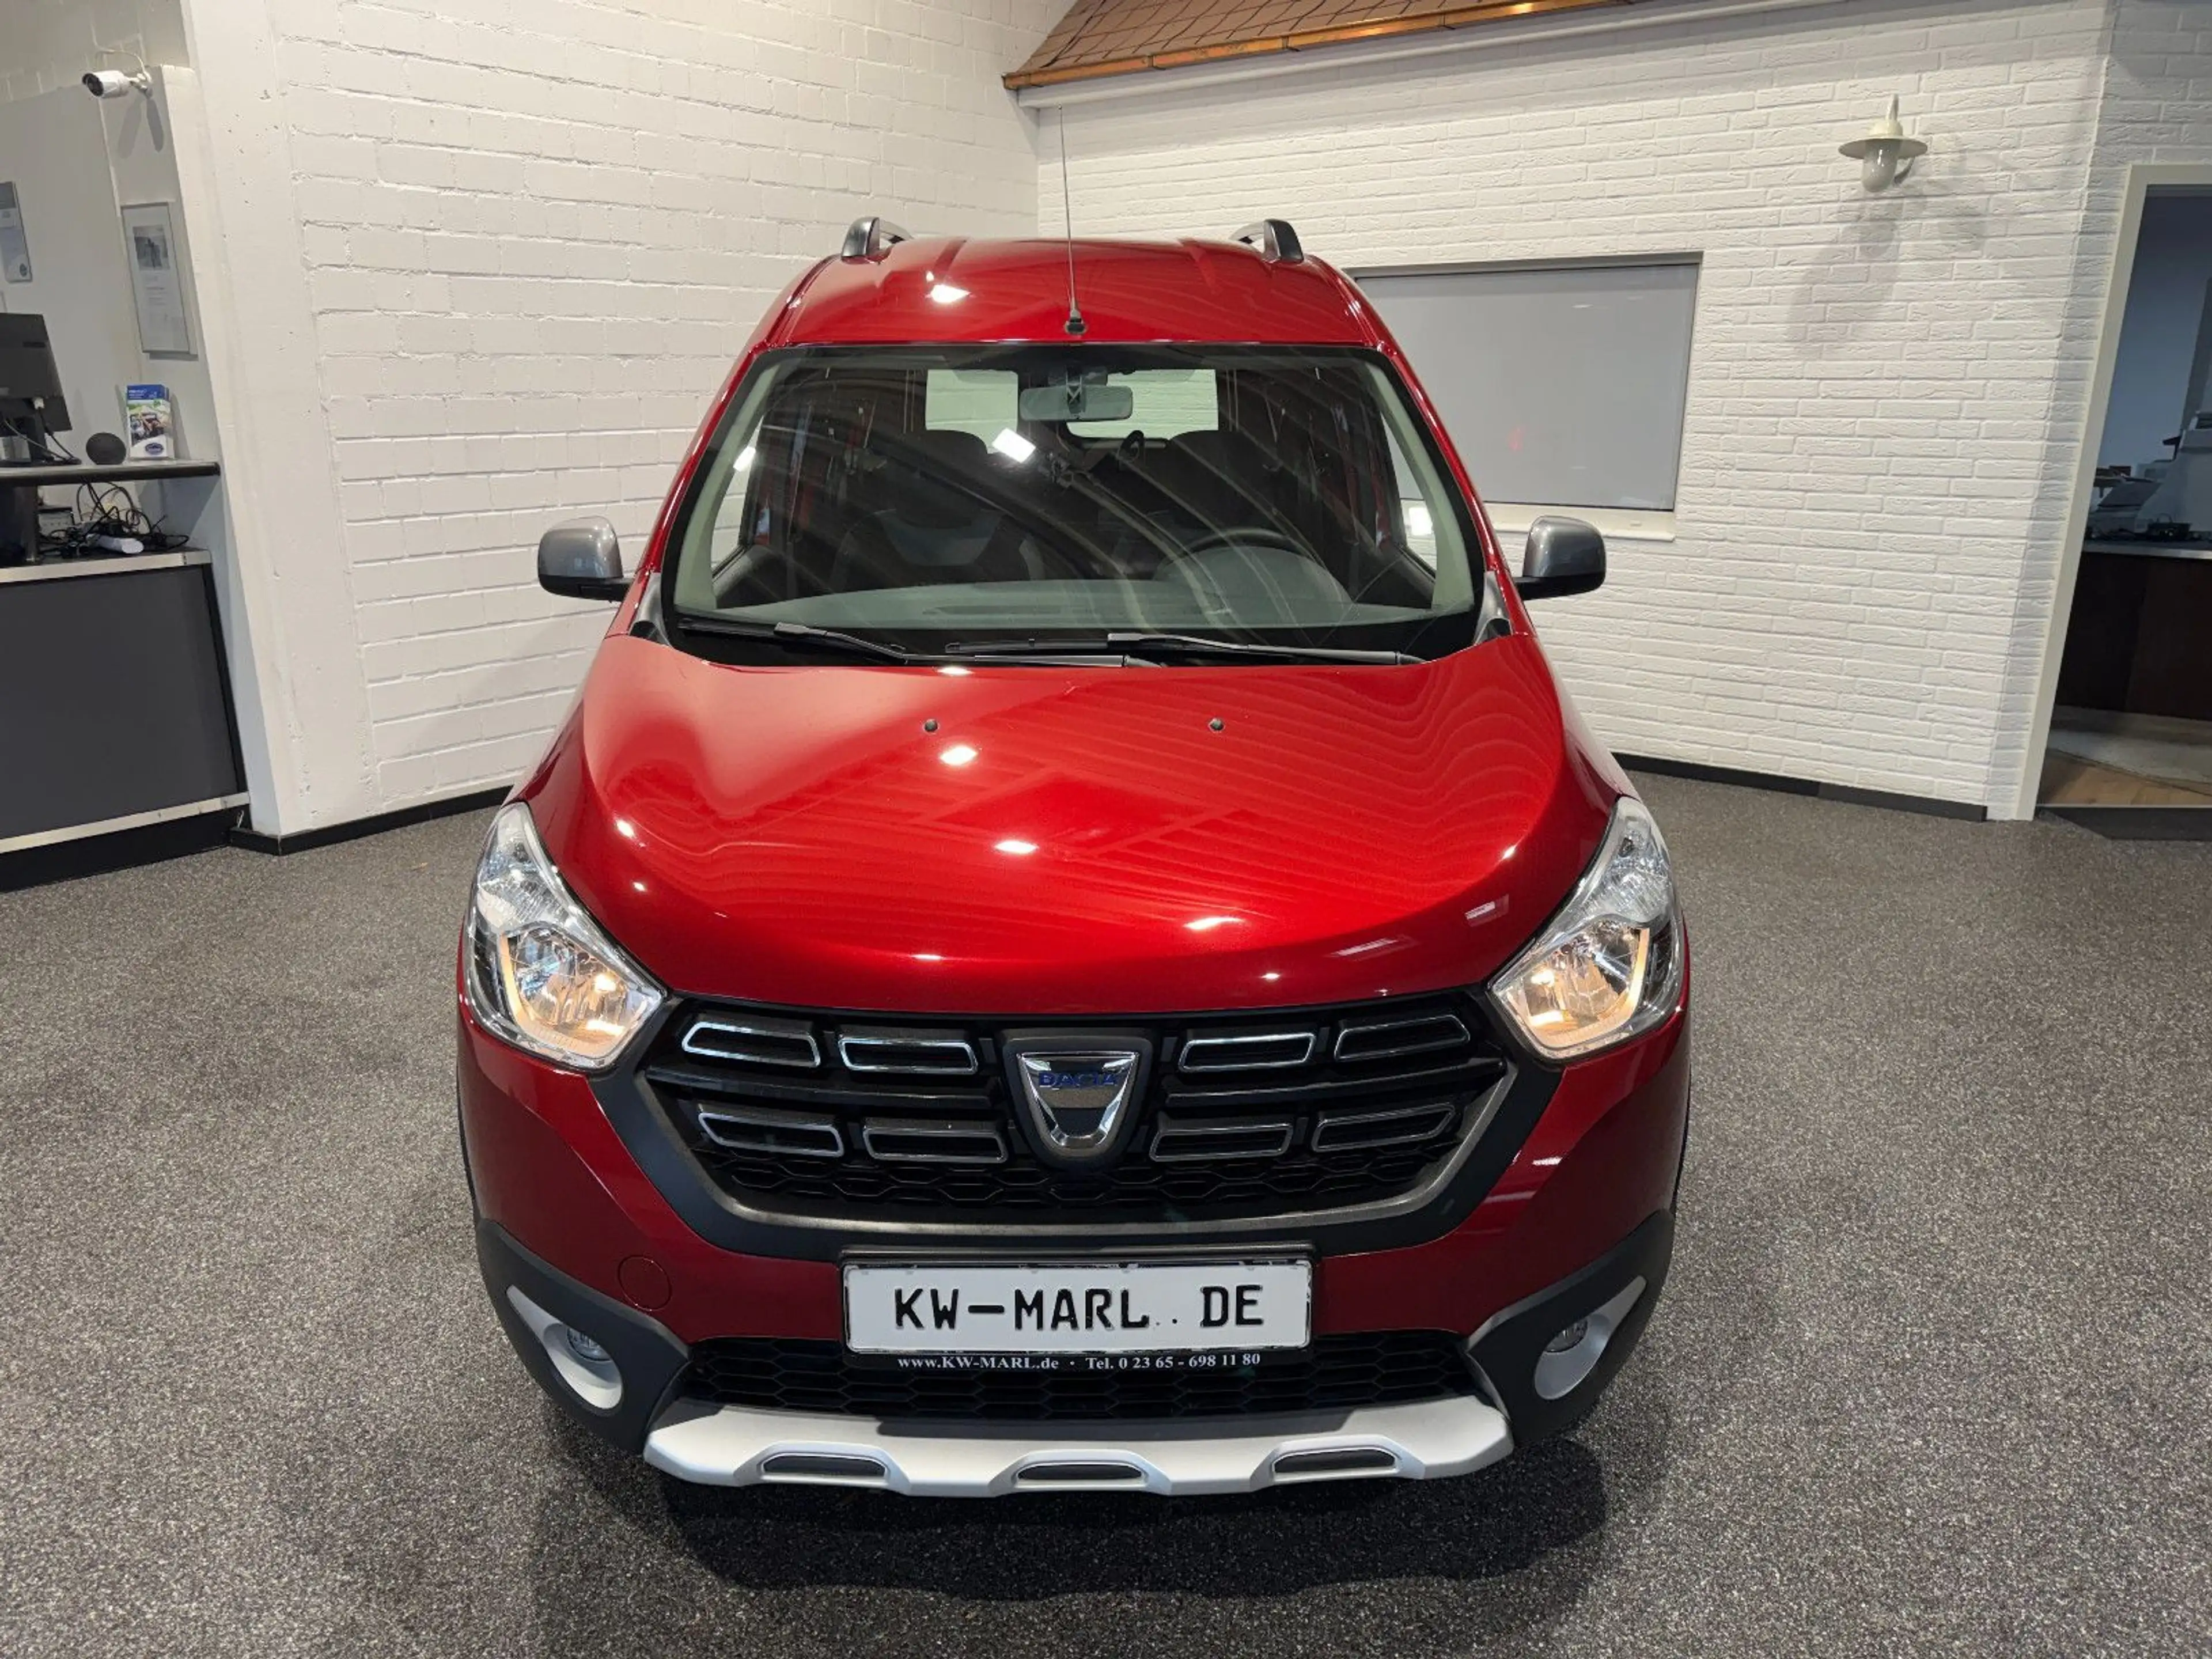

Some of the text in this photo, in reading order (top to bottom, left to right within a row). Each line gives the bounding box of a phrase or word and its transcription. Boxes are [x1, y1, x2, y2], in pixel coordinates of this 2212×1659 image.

[897, 1356, 1059, 1369] www.KW-MARL.de
[1086, 1357, 1113, 1369] Tel.
[1119, 1357, 1127, 1369] 0
[1132, 1357, 1150, 1369] 23
[1156, 1355, 1173, 1368] 65
[1189, 1354, 1216, 1368] 698
[1223, 1354, 1236, 1366] 11
[1243, 1353, 1260, 1365] 80
